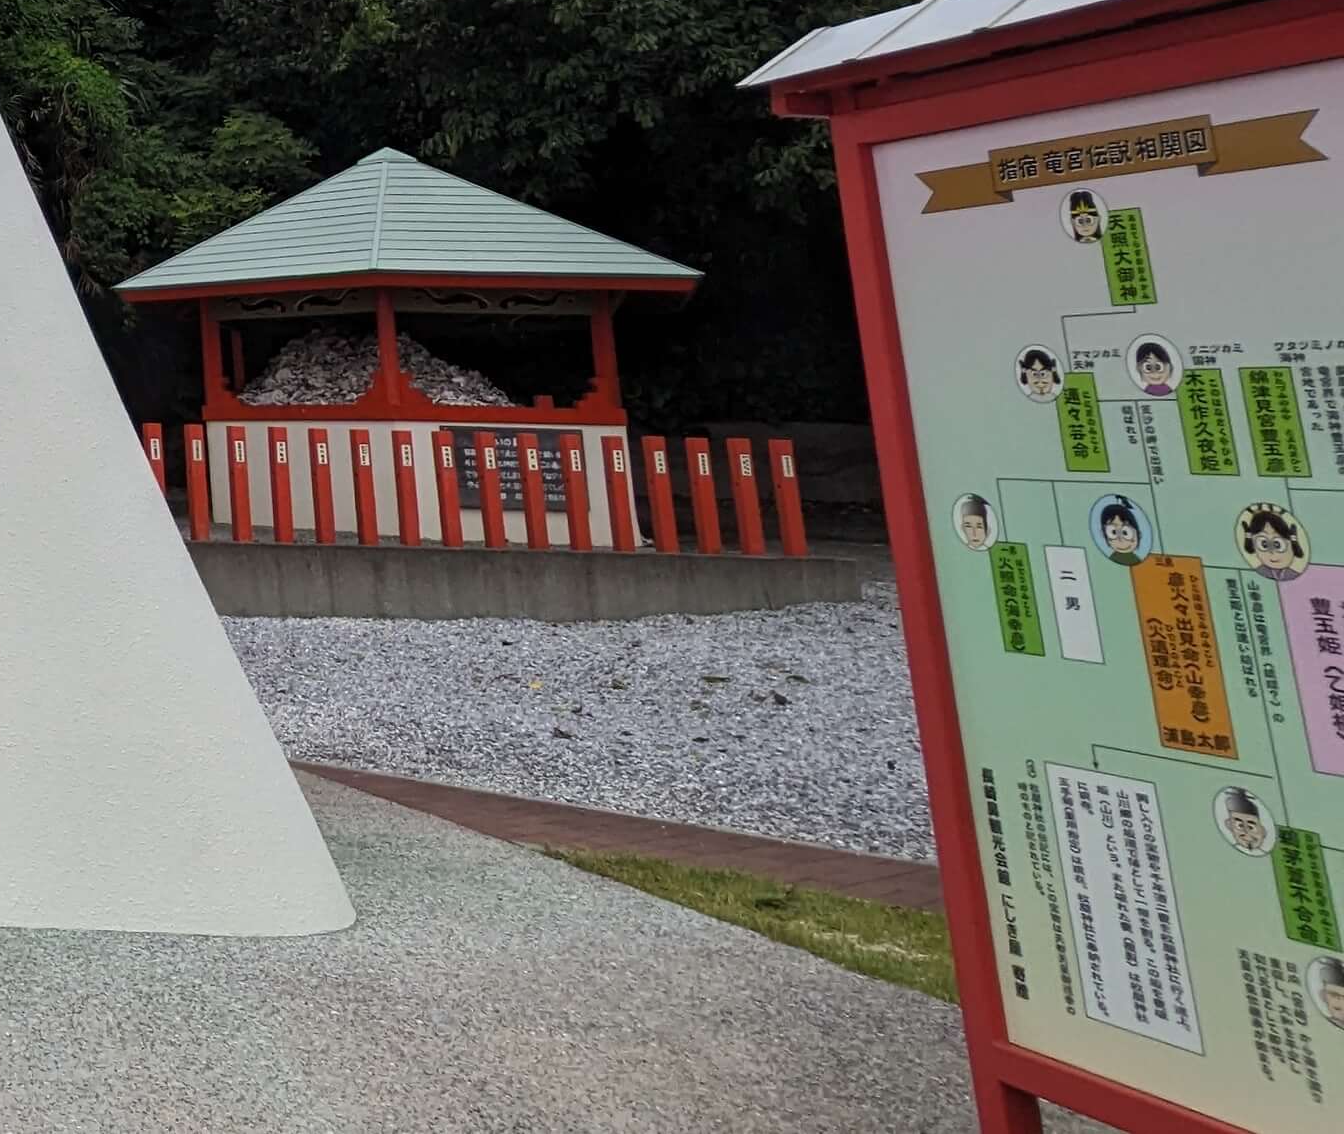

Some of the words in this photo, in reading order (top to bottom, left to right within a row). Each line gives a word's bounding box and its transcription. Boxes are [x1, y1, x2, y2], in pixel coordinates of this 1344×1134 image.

[1108, 214, 1137, 301] 天照大御神
[1060, 570, 1081, 611] 二男
[1163, 726, 1232, 753] 浦島太郎
